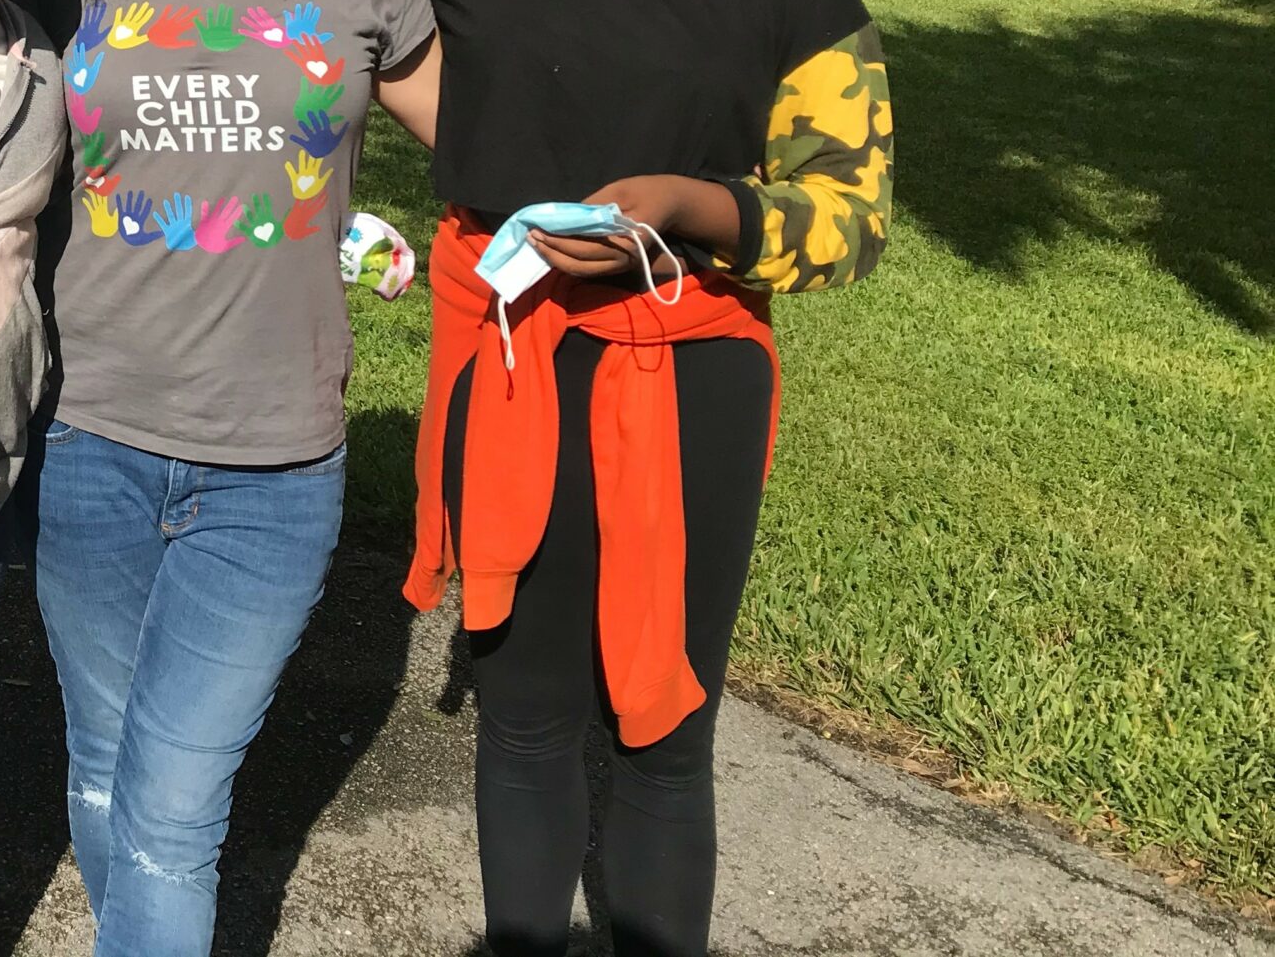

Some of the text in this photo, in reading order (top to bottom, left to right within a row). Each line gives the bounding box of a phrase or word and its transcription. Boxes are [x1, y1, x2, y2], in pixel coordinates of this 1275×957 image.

[132, 74, 260, 100] EVERY
[136, 100, 260, 126] CHILD
[120, 125, 286, 152] MATTERS
